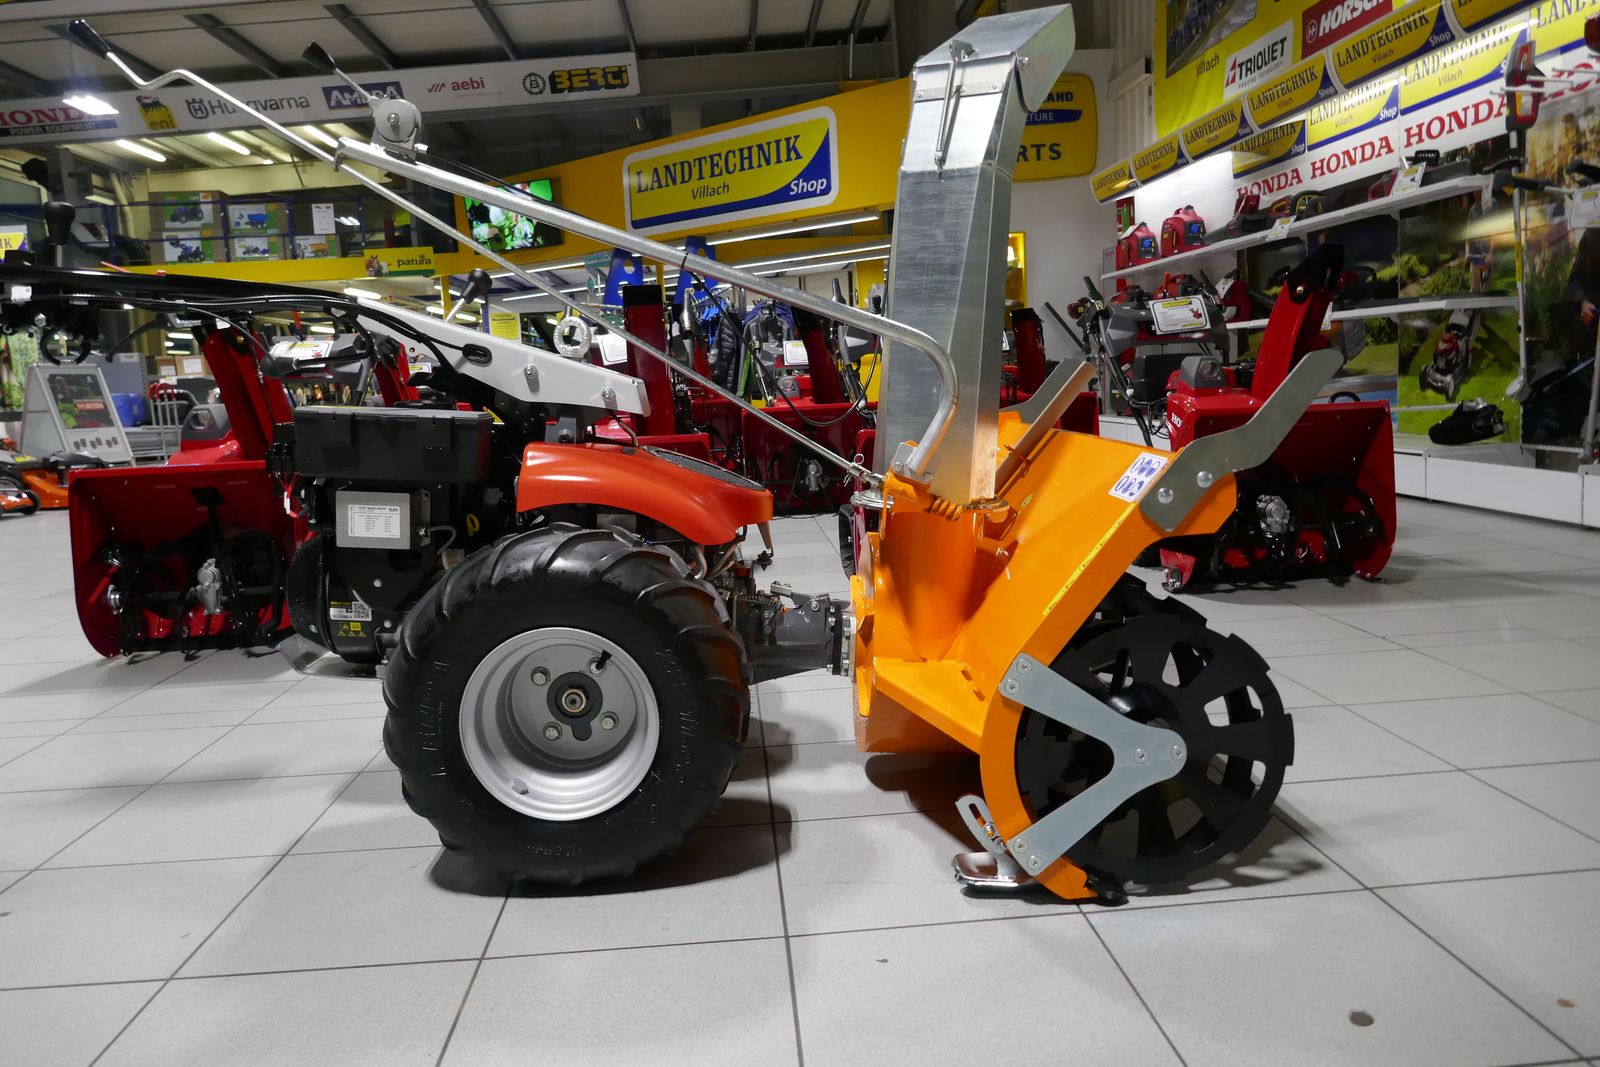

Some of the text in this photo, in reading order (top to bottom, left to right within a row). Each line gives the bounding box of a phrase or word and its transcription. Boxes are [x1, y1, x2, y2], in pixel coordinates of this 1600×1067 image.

[1337, 8, 1430, 67] LANDTECHNIK
[1429, 31, 1451, 47] Shop
[1370, 48, 1394, 64] Villach
[451, 77, 485, 92] aebi
[1438, 69, 1463, 87] Villach
[330, 86, 402, 106] AMRA
[1251, 65, 1318, 111] LANDTECHNIK
[1319, 87, 1335, 98] Shop
[208, 95, 311, 116] Huqvarna
[1379, 107, 1397, 120] Shop
[151, 118, 177, 131] eni
[1184, 108, 1238, 145] LANDTECHNIK
[1290, 143, 1305, 155] Shop
[1311, 135, 1394, 180] HONDA
[635, 134, 803, 194] LANDTECHNIK
[691, 181, 730, 201] Villach
[789, 177, 827, 196] Shop
[1236, 168, 1303, 197] HONDA
[397, 257, 432, 268] patura
